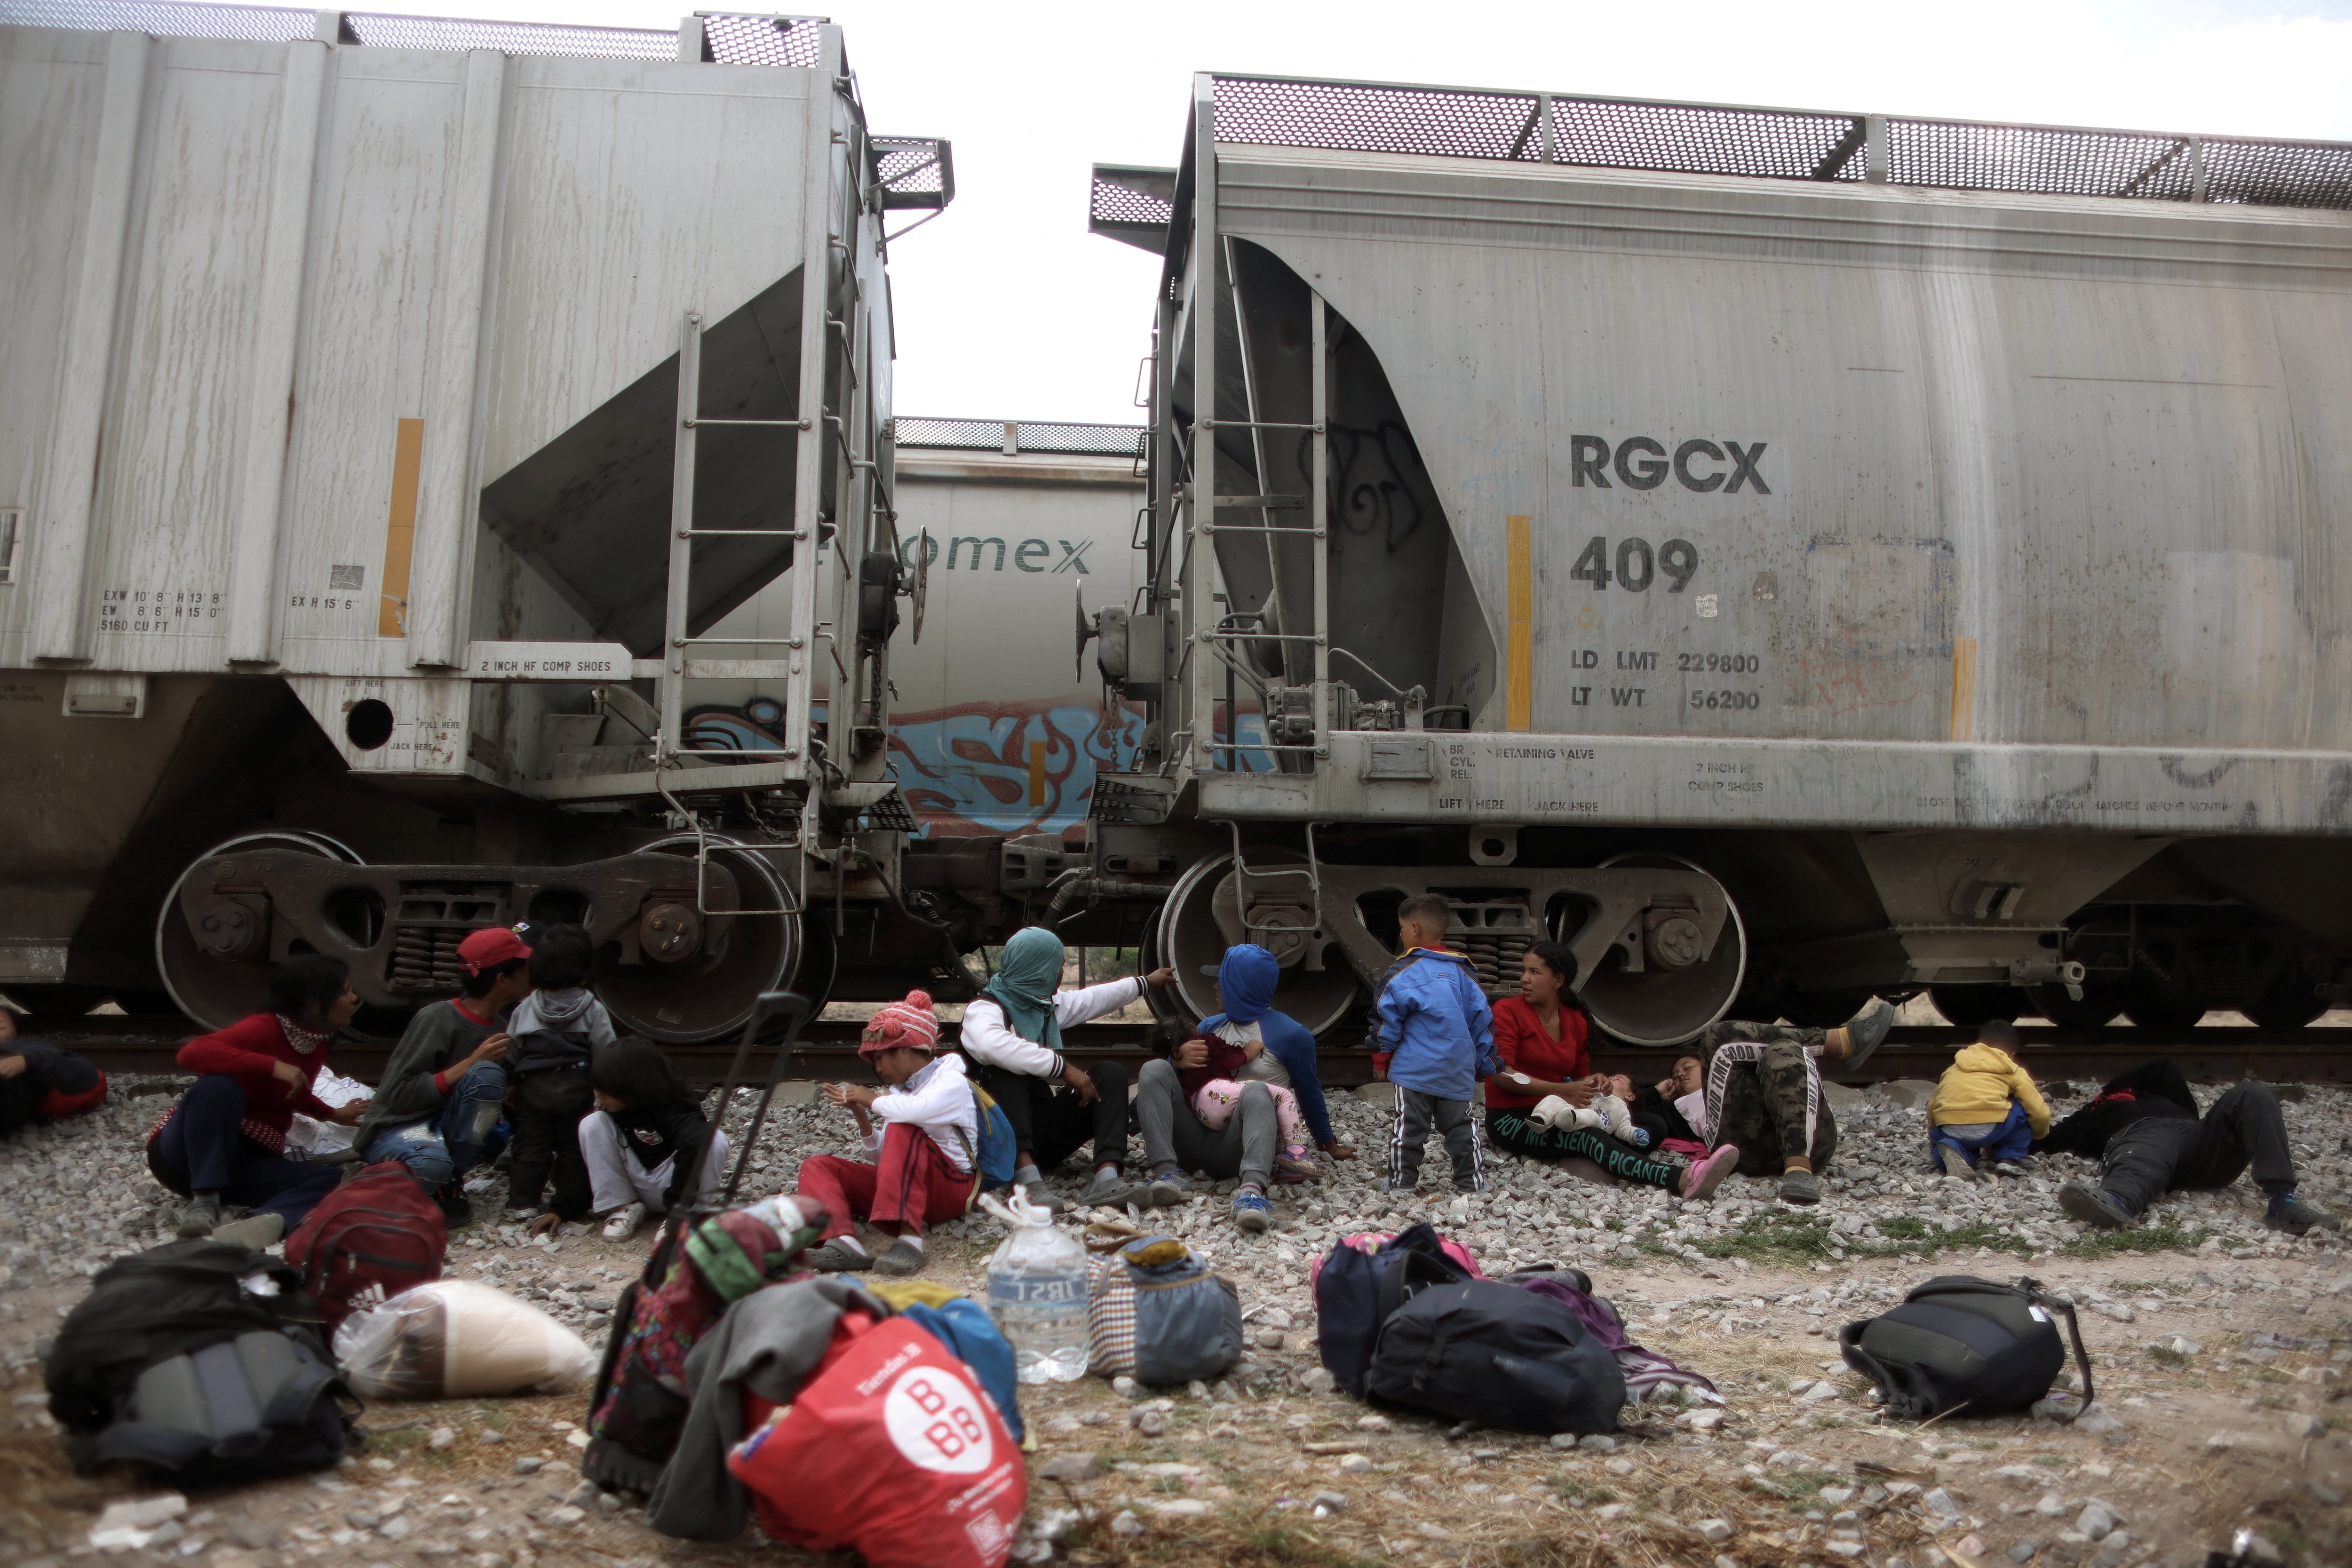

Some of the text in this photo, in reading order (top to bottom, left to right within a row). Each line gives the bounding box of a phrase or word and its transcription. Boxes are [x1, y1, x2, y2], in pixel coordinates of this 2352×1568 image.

[1571, 434, 1772, 494] RGCX
[1570, 536, 1698, 593] 409
[103, 590, 127, 601] EXW
[177, 593, 184, 603] H
[292, 596, 305, 607] EX
[311, 597, 318, 607] H
[102, 605, 117, 616] EW
[175, 607, 183, 617] H
[101, 620, 168, 632] 5160 CU FT
[481, 661, 610, 672] 2 INCH HF COMP SHOES
[1571, 650, 1759, 674] LD LMT 229800
[1571, 686, 1760, 709] LT WT 56200
[1495, 748, 1556, 759] RETAINING
[1449, 757, 1476, 767] CYL.
[1696, 763, 1703, 772] 2
[1708, 763, 1736, 773] INCH
[1450, 770, 1472, 780] REL.
[1688, 781, 1764, 792] COMP SHOES
[1438, 798, 1505, 810] LIFT HERE
[1535, 802, 1599, 812] JACK HERE
[1722, 1045, 1755, 1061] GOOD
[1711, 1056, 1731, 1090] TIME
[1808, 1081, 1818, 1116] TIME
[1709, 1090, 1722, 1127] GOOD
[1494, 1114, 1671, 1186] HOY ME SIENTO PICANTE
